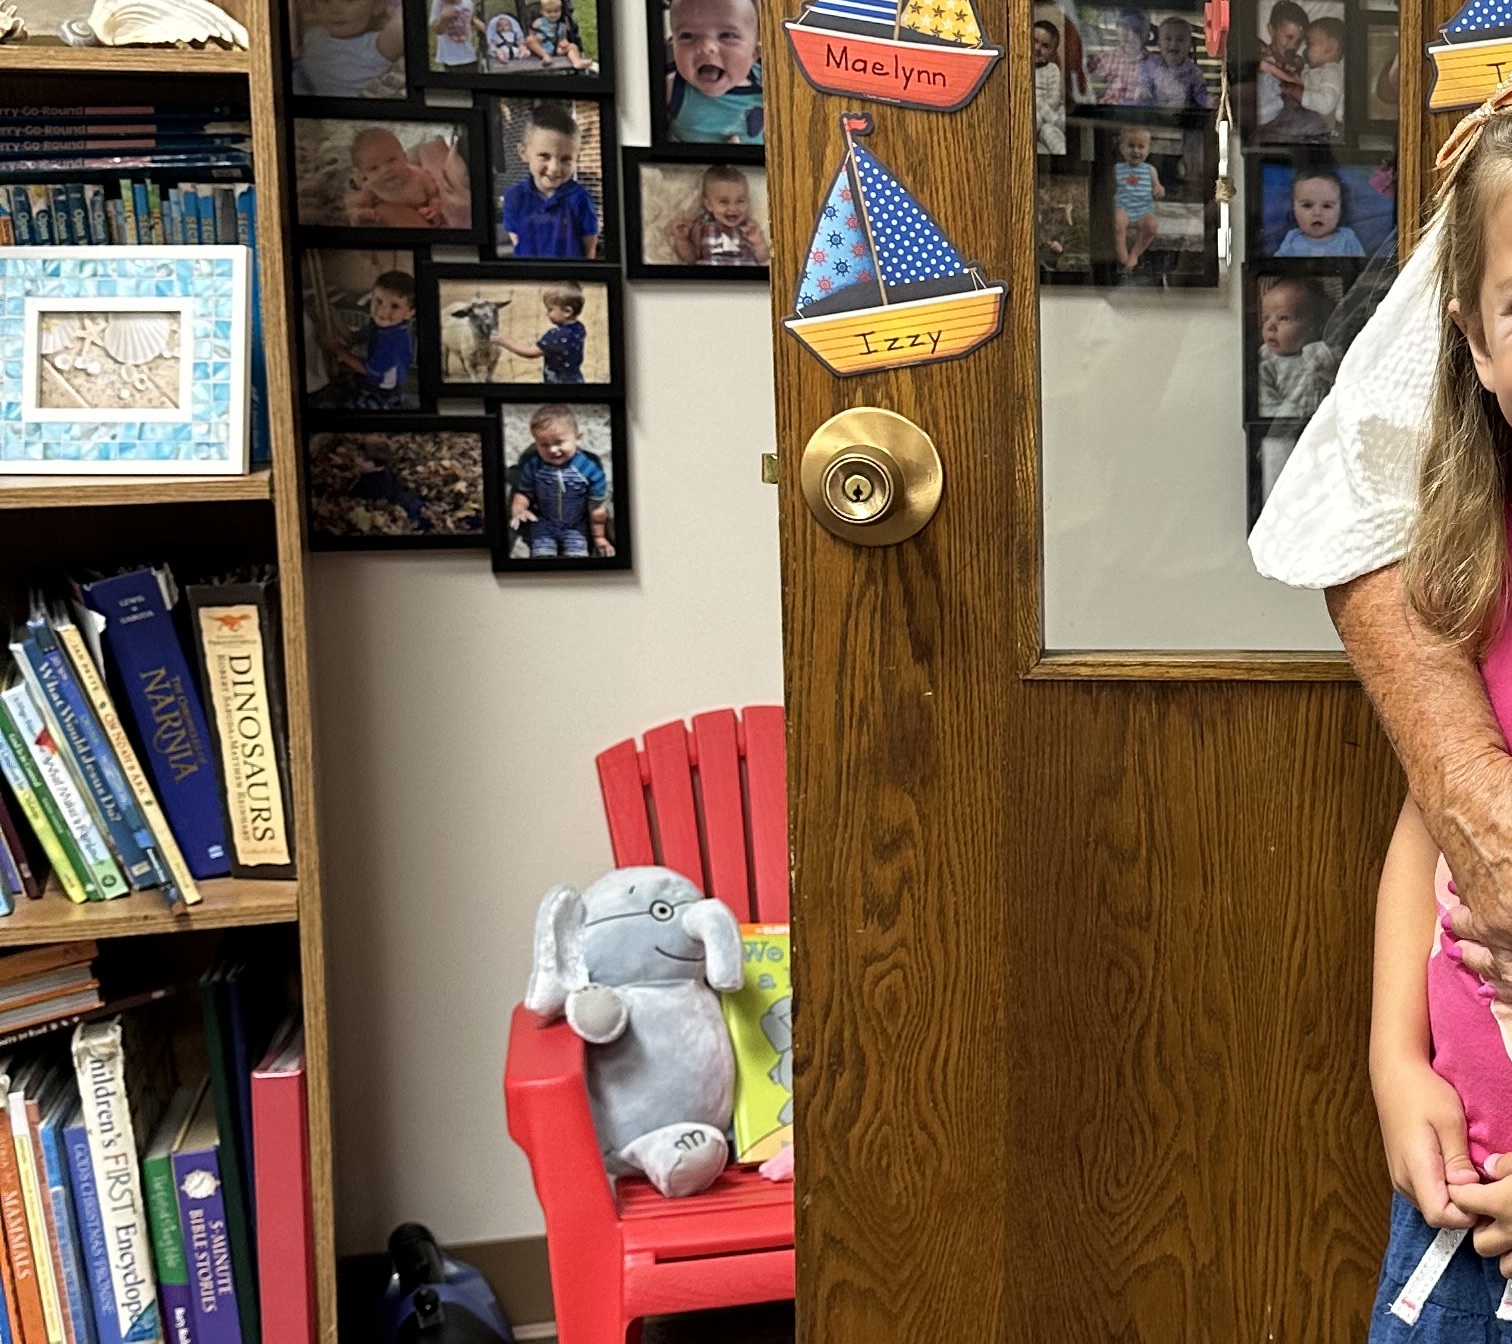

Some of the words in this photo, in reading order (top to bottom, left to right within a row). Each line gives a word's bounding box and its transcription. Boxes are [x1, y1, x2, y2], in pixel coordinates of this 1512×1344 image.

[825, 44, 947, 92] Maelynn
[856, 328, 943, 357] Izzy
[36, 660, 67, 707] What
[56, 704, 91, 754] Would
[79, 751, 110, 796] Jesus
[140, 666, 199, 783] NARNIA
[229, 655, 275, 843] DINOSAURS
[103, 1152, 137, 1218] FIRST
[2, 1191, 32, 1280] MAMMALS
[189, 1209, 209, 1249] BIBLE
[197, 1253, 217, 1313] STORIES
